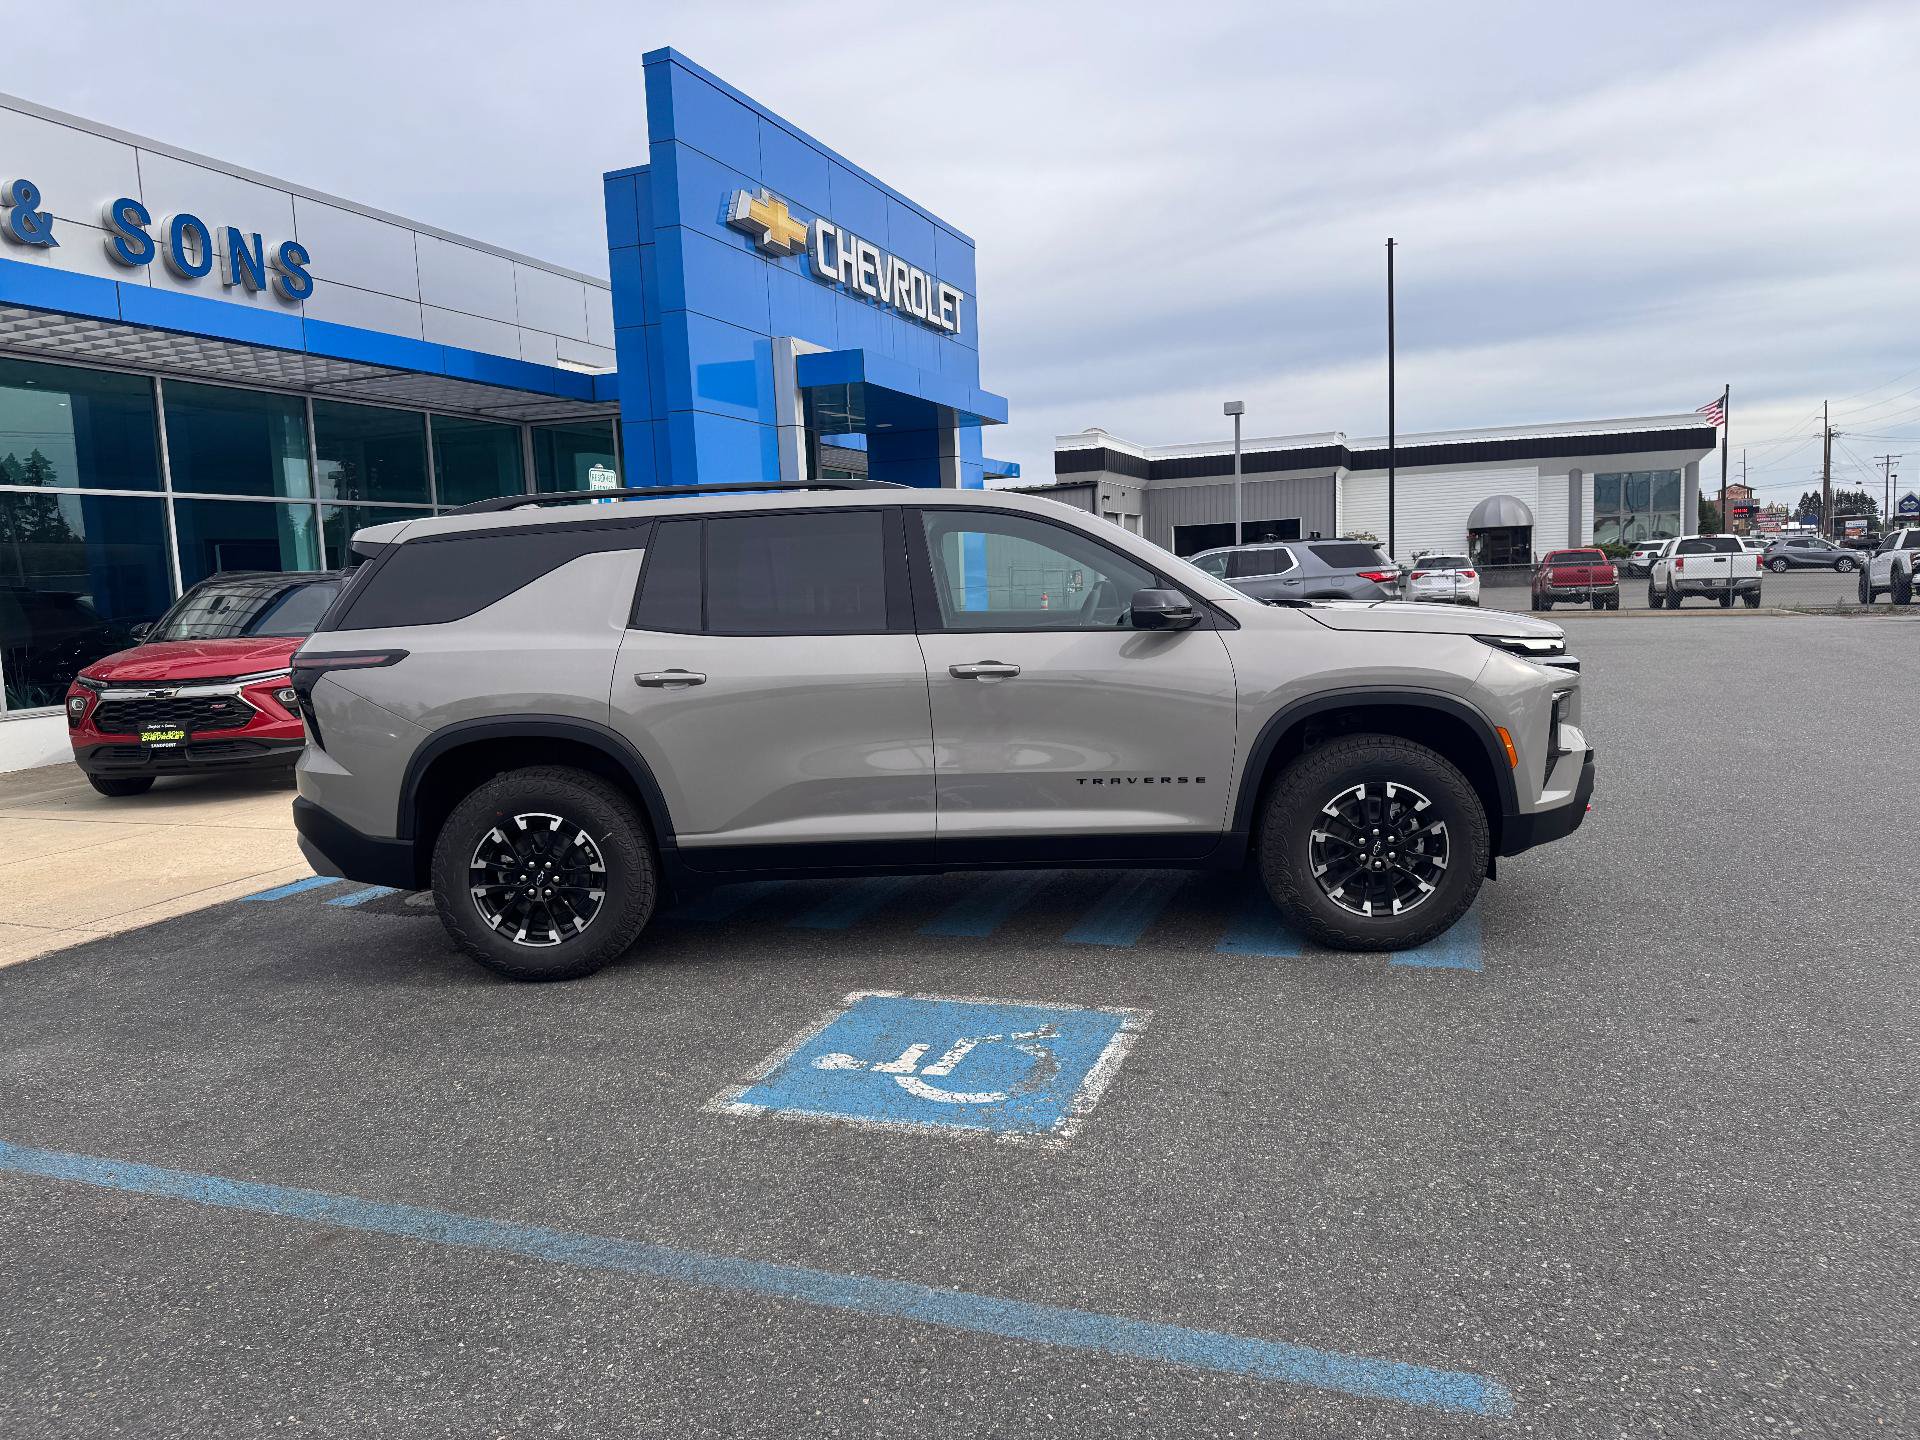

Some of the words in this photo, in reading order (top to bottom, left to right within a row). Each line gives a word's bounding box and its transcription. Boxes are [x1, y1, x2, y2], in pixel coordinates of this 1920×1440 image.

[1, 178, 60, 248] &
[102, 197, 314, 302] SONS
[810, 218, 965, 335] CHEVROLET
[1076, 776, 1207, 785] TRAVERSE
